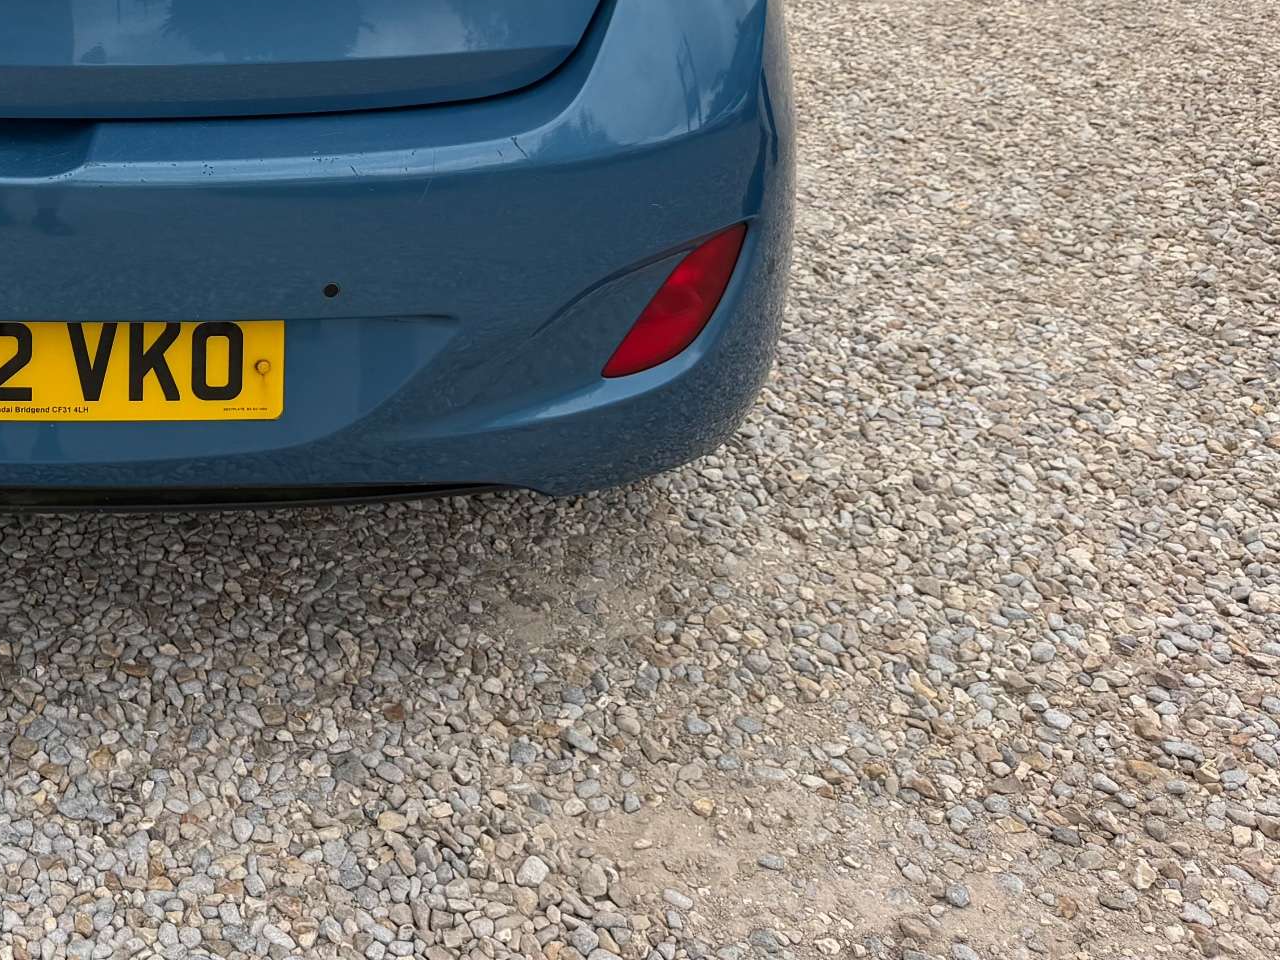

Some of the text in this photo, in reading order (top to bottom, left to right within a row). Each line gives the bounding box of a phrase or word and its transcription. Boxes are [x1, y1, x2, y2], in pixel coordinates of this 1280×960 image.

[66, 321, 243, 402] VKO
[15, 406, 50, 415] Bridgend
[52, 406, 71, 414] CF31
[73, 406, 89, 414] 4LH
